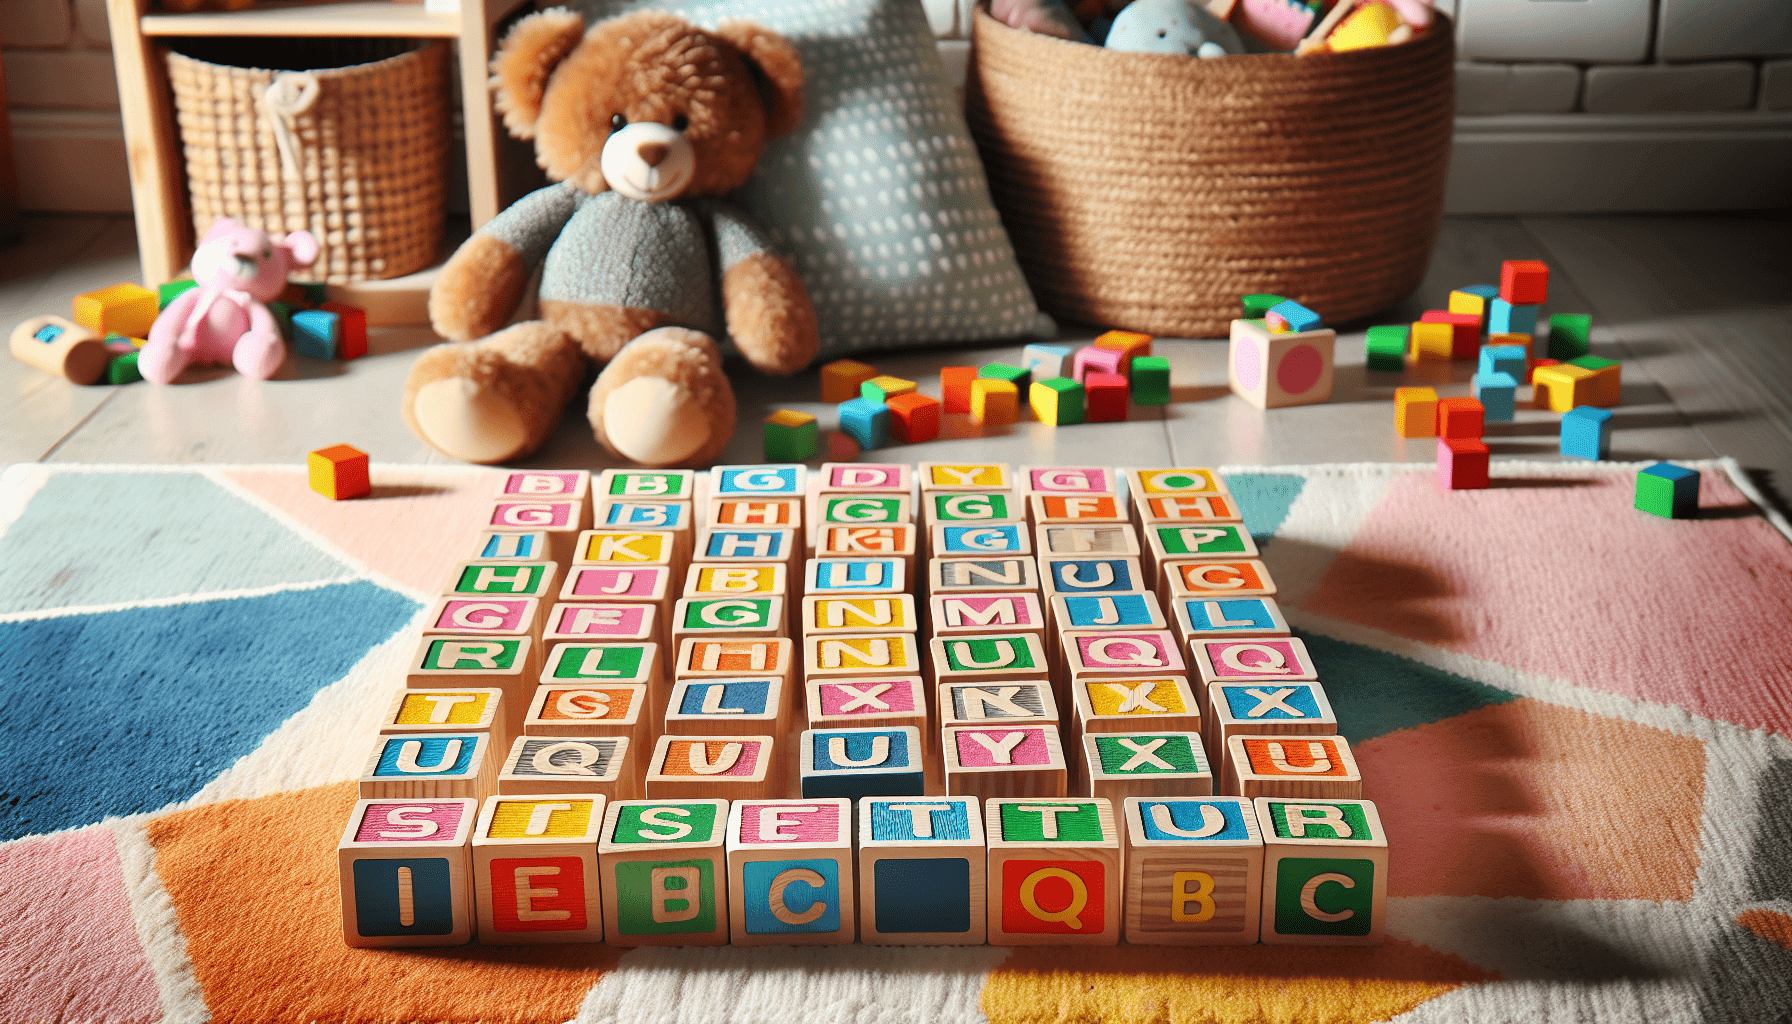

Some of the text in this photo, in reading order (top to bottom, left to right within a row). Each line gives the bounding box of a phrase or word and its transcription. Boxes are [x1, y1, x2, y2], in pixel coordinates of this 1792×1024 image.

[519, 474, 565, 493] B
[624, 475, 669, 494] B
[733, 469, 785, 491] G
[842, 469, 887, 485] D
[942, 468, 985, 485] Y
[1040, 470, 1090, 490] G
[1150, 473, 1206, 491] O
[504, 505, 553, 524] G
[622, 504, 667, 527] B
[732, 502, 778, 523] H
[832, 500, 888, 521] G
[946, 495, 993, 518] G
[1065, 498, 1098, 518] F
[1161, 498, 1216, 518] H
[495, 535, 521, 557] I
[599, 537, 651, 559] K
[720, 535, 772, 556] H
[960, 529, 1008, 549] G
[1180, 529, 1227, 552] P
[474, 568, 532, 591] H
[601, 572, 634, 594] J
[711, 569, 759, 592] B
[830, 563, 882, 586] U
[955, 561, 1020, 585] N
[1061, 562, 1114, 588] U
[453, 603, 509, 628] G
[570, 609, 622, 633] F
[701, 601, 760, 625] G
[827, 600, 891, 626] N
[945, 599, 1016, 625] M
[1093, 597, 1119, 624] J
[1204, 601, 1254, 627] L
[437, 642, 504, 669] R
[578, 649, 621, 675] L
[823, 640, 889, 667] N
[953, 641, 1015, 668] U
[1088, 637, 1162, 666] Q
[1221, 644, 1290, 674] Q
[426, 695, 476, 723] T
[556, 691, 611, 718] S
[701, 685, 744, 713] L
[835, 684, 892, 712] X
[1105, 682, 1168, 712] X
[1244, 689, 1305, 717] X
[396, 740, 462, 772] U
[533, 742, 600, 776] Q
[829, 736, 889, 767] U
[969, 732, 1030, 763] Y
[1118, 738, 1176, 770] X
[1268, 743, 1332, 772] U
[380, 807, 439, 837] S
[638, 807, 692, 840] S
[759, 807, 819, 840] E
[889, 805, 950, 837] T
[1018, 806, 1079, 839] T
[1151, 804, 1225, 837] U
[1284, 804, 1352, 837] R
[397, 867, 415, 926] I
[515, 867, 571, 921] E
[651, 867, 700, 923] B
[769, 868, 827, 924] C
[1020, 868, 1088, 929] Q
[1172, 871, 1215, 922] B
[1300, 872, 1355, 922] C
